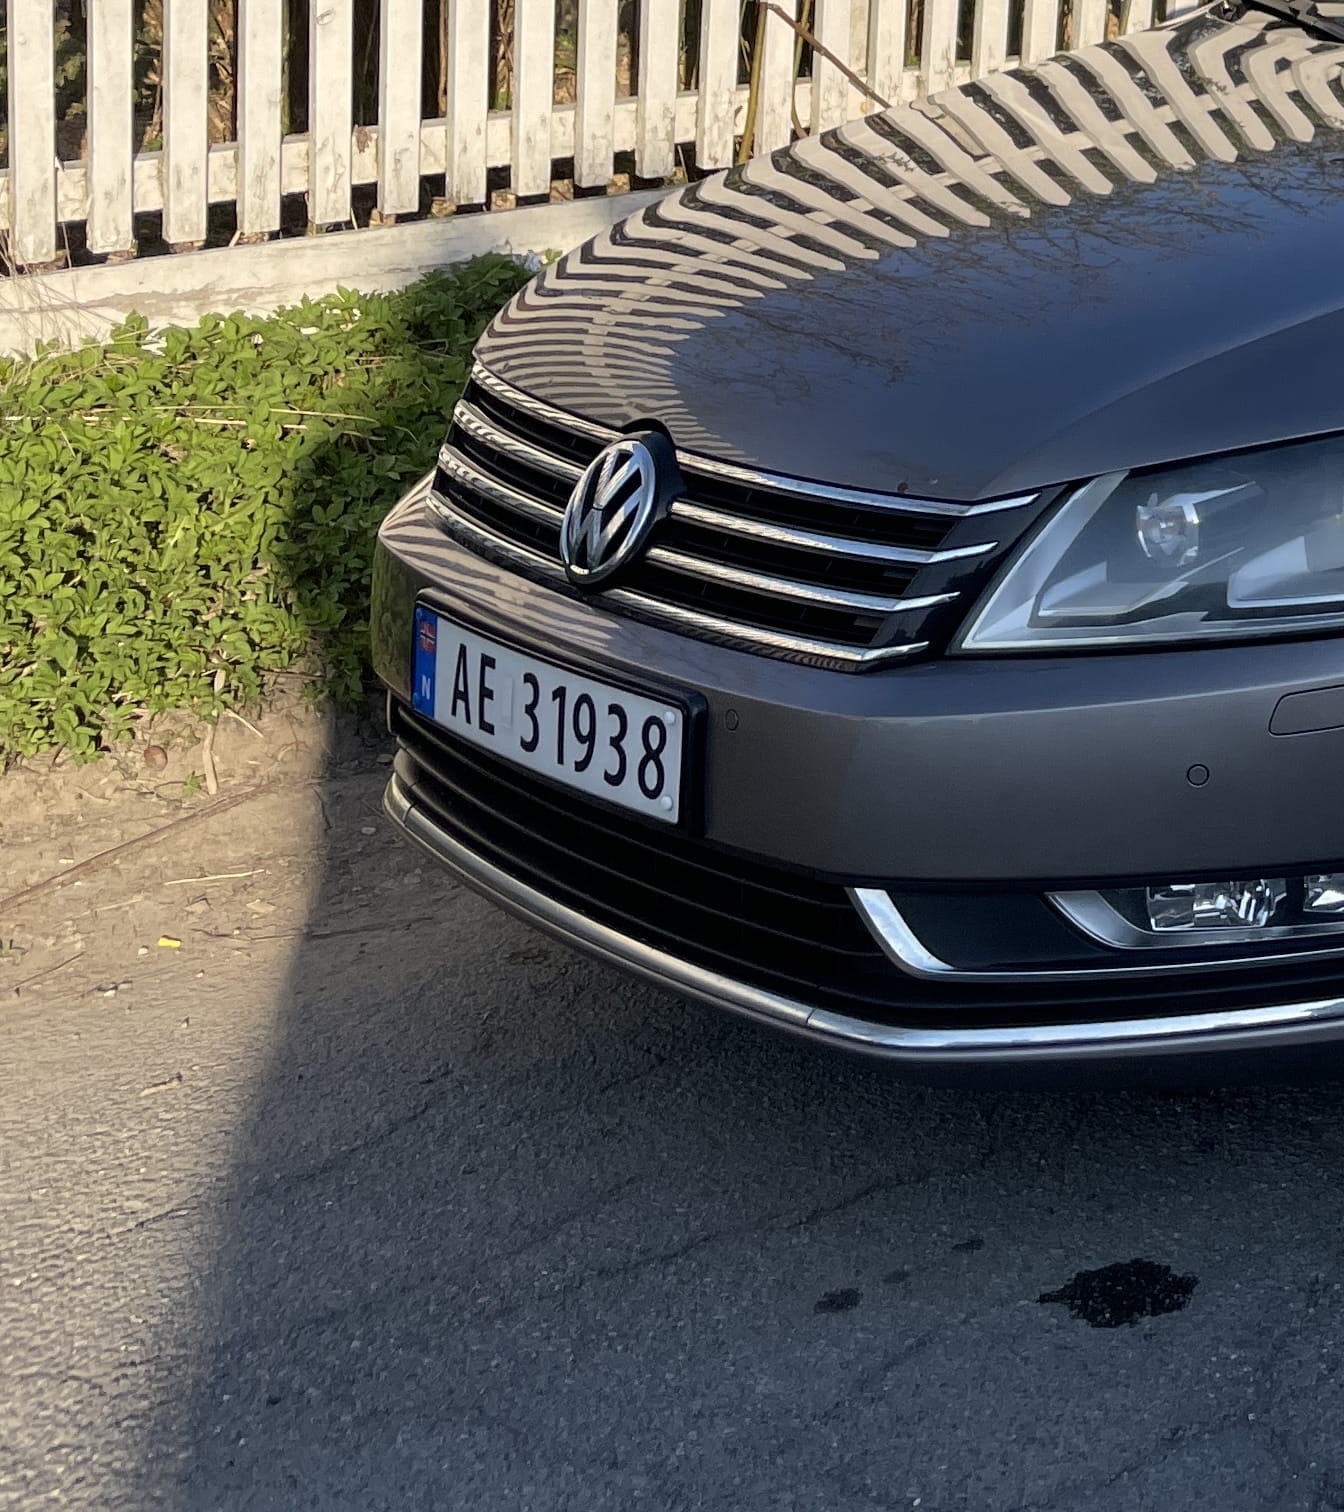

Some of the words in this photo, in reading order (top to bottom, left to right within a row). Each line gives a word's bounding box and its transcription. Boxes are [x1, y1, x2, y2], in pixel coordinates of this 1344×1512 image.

[420, 674, 431, 700] N
[451, 643, 496, 736] AE
[520, 672, 667, 800] 31938
